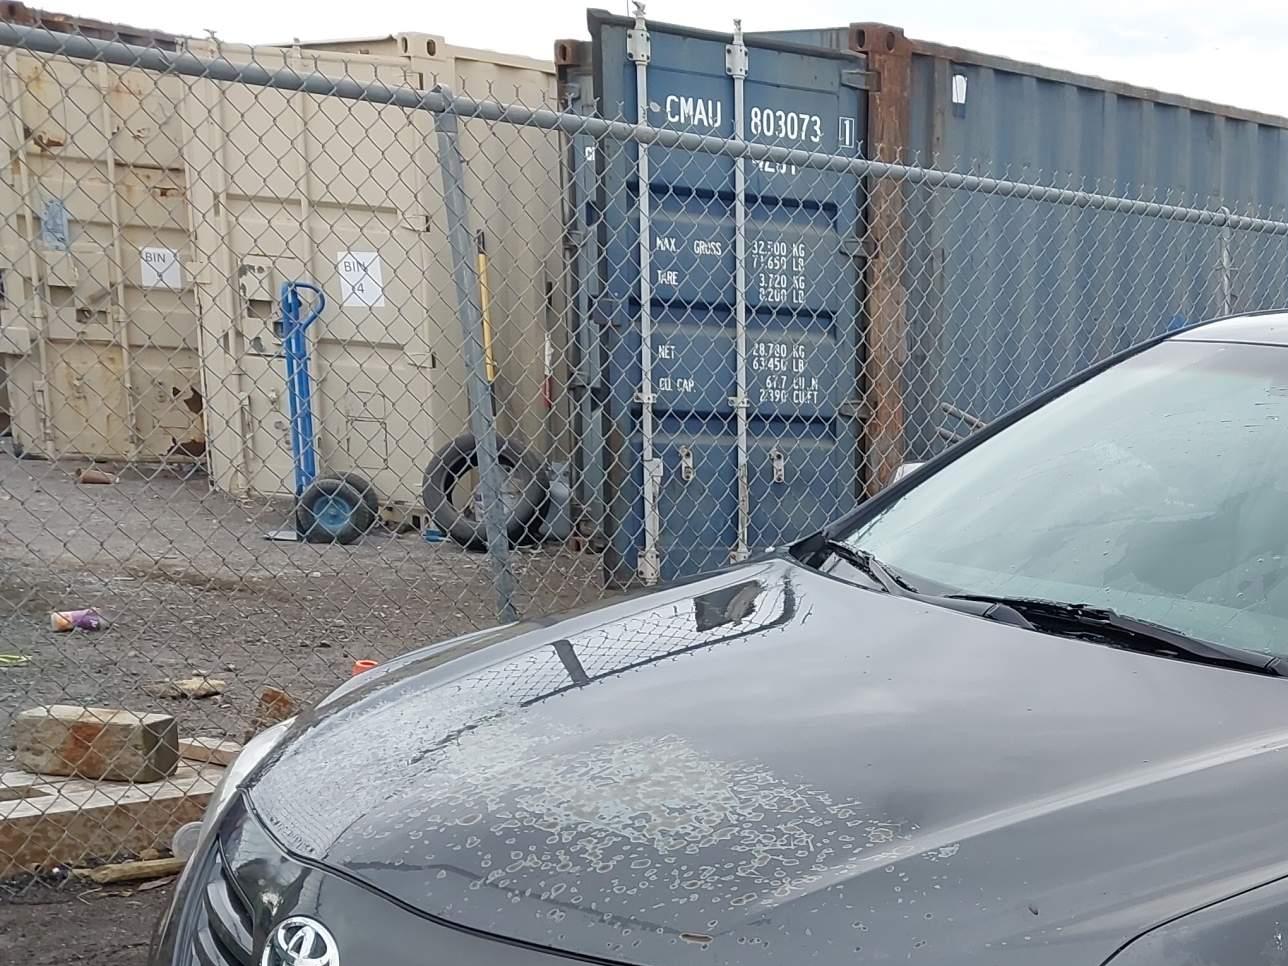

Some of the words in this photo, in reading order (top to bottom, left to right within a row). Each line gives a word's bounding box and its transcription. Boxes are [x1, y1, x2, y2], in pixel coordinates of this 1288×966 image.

[666, 95, 721, 127] CMAU
[750, 107, 821, 142] 803073
[693, 240, 722, 255] GROSS
[792, 243, 805, 257] KG
[145, 251, 166, 264] BIN
[344, 261, 366, 272] BIN
[792, 258, 805, 271] LB
[656, 269, 678, 286] TARE
[792, 276, 805, 289] KG
[357, 283, 364, 294] 4
[792, 290, 805, 303] LB
[658, 345, 676, 359] NET
[792, 345, 805, 358] KG
[792, 359, 805, 372] LB
[676, 378, 696, 392] CAP.
